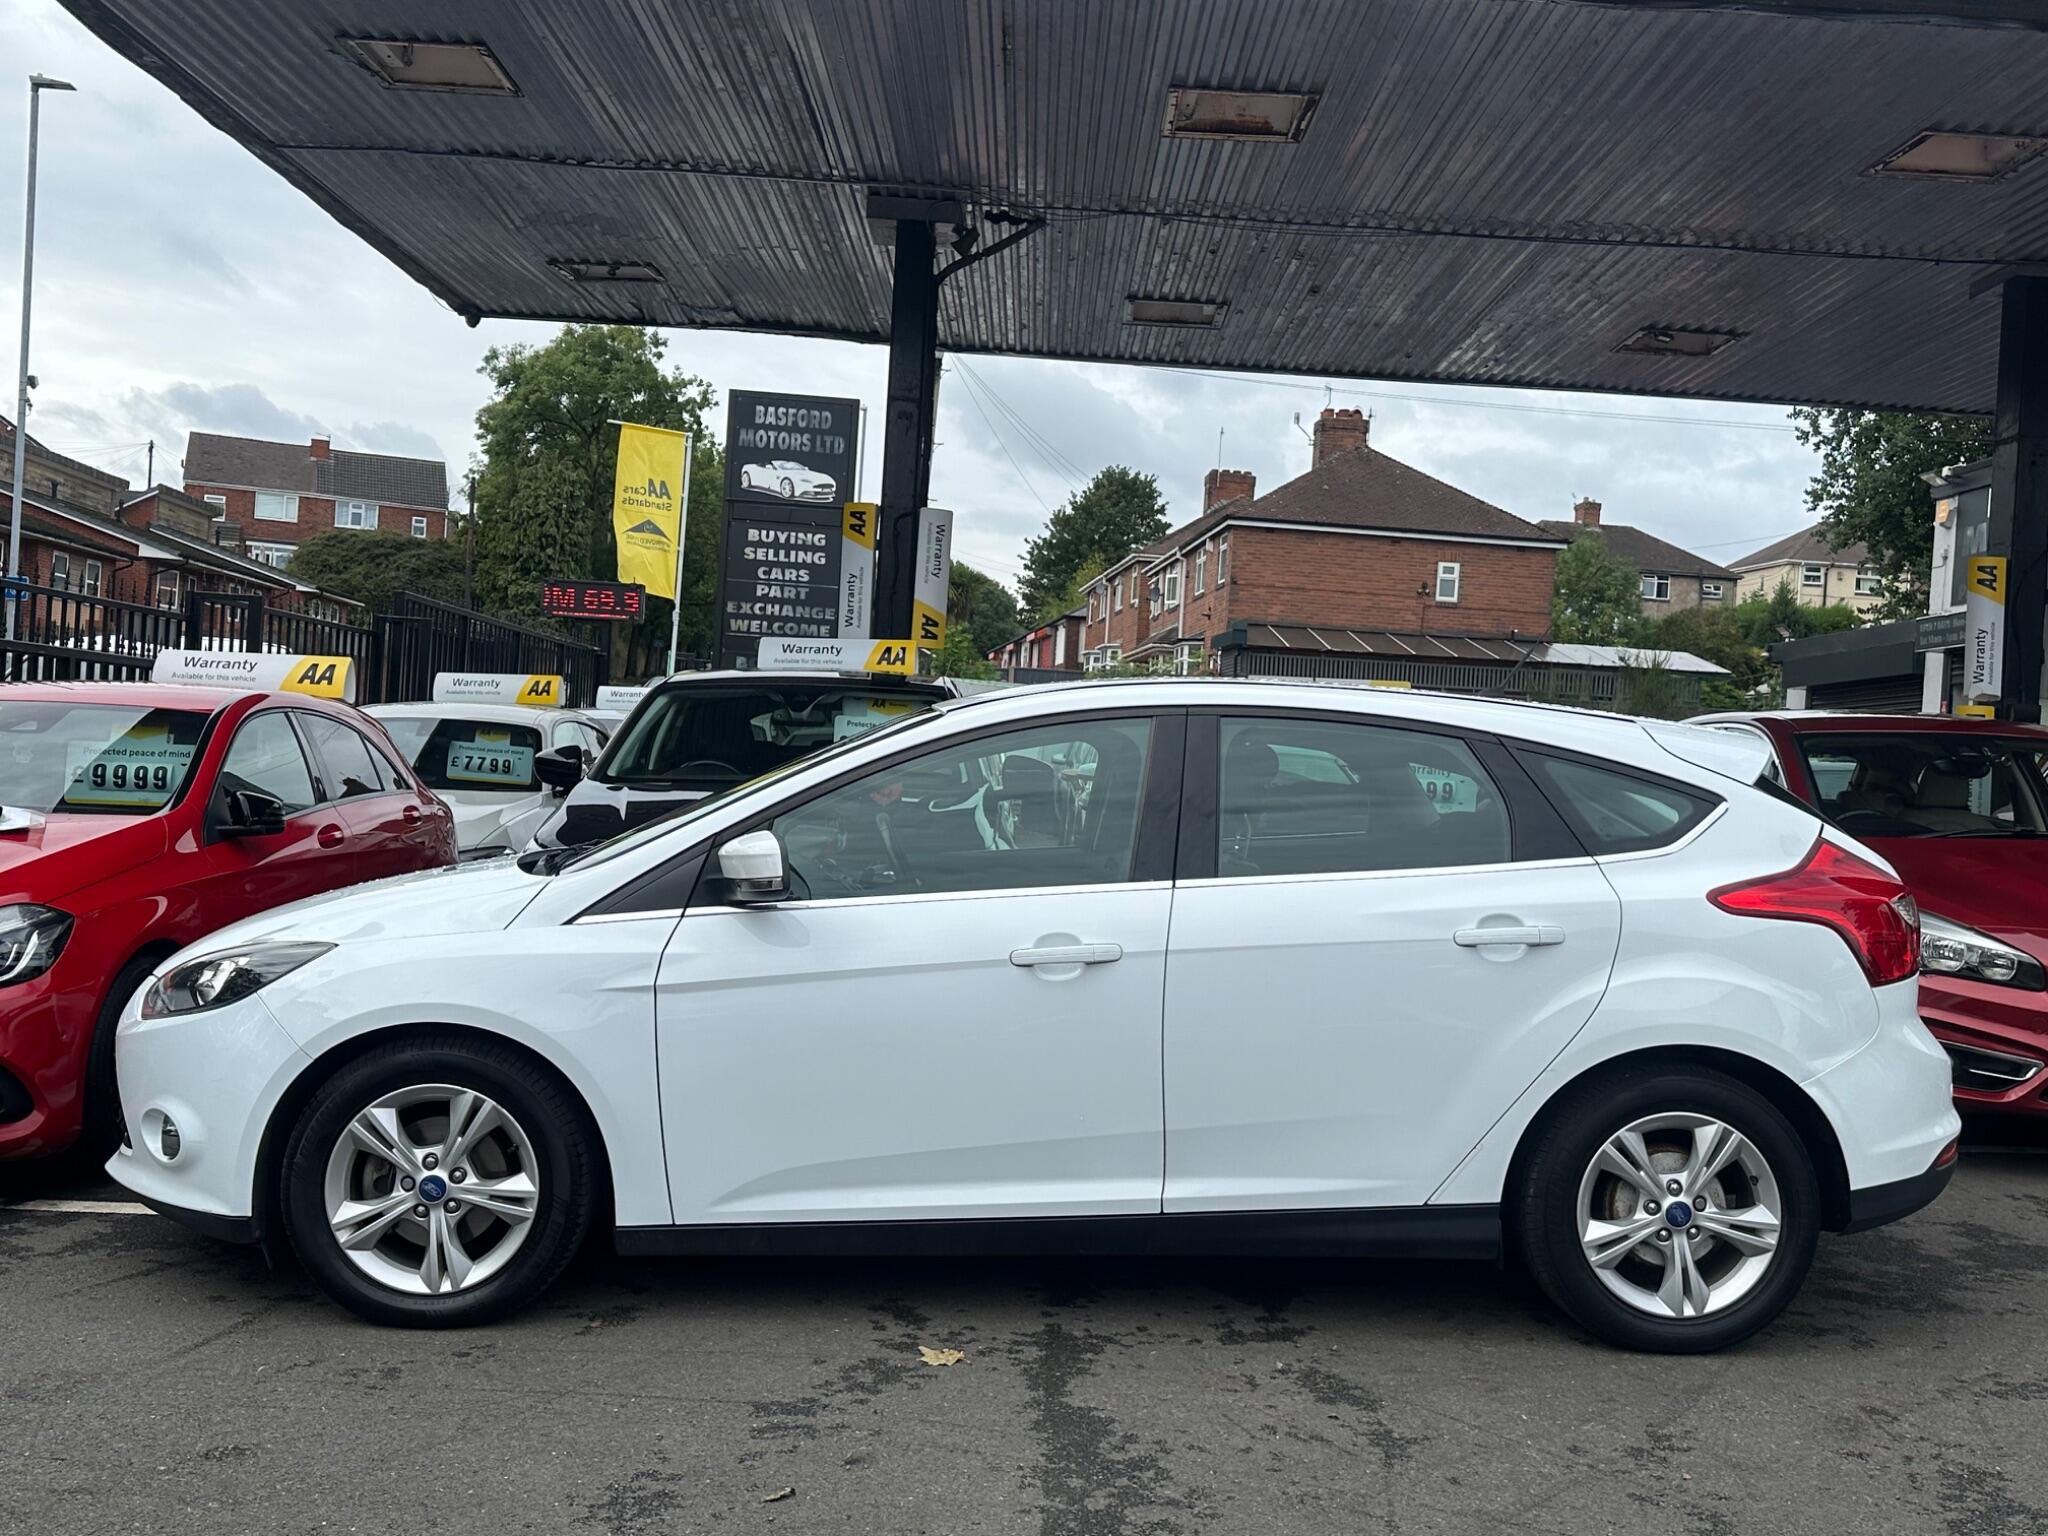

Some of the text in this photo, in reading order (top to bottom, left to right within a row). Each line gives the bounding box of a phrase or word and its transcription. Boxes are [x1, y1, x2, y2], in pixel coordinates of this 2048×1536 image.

[755, 405, 832, 430] BASFORD
[738, 428, 845, 454] MOTORS LTD
[849, 511, 866, 537] AA
[748, 529, 826, 546] BUYING
[744, 547, 826, 565] SELLING
[931, 524, 946, 578] Warranty
[757, 567, 810, 582] CARS
[1977, 565, 1998, 592] AA
[756, 584, 810, 600] PART
[844, 573, 857, 628] Warranty
[726, 601, 836, 620] EXCHANGE
[729, 619, 831, 637] WELCOME
[920, 613, 939, 641] AA
[782, 644, 842, 656] Warranty
[876, 647, 906, 666] AA
[1973, 628, 1988, 684] Warranty
[184, 656, 258, 673] Warranty
[297, 663, 336, 685] AA
[171, 672, 204, 680] Available
[217, 673, 230, 681] this
[231, 674, 256, 682] vehicle
[452, 678, 501, 689] Warranty
[527, 680, 551, 696] AA
[83, 746, 191, 758] Protected peace of mind
[451, 755, 512, 774] £7799
